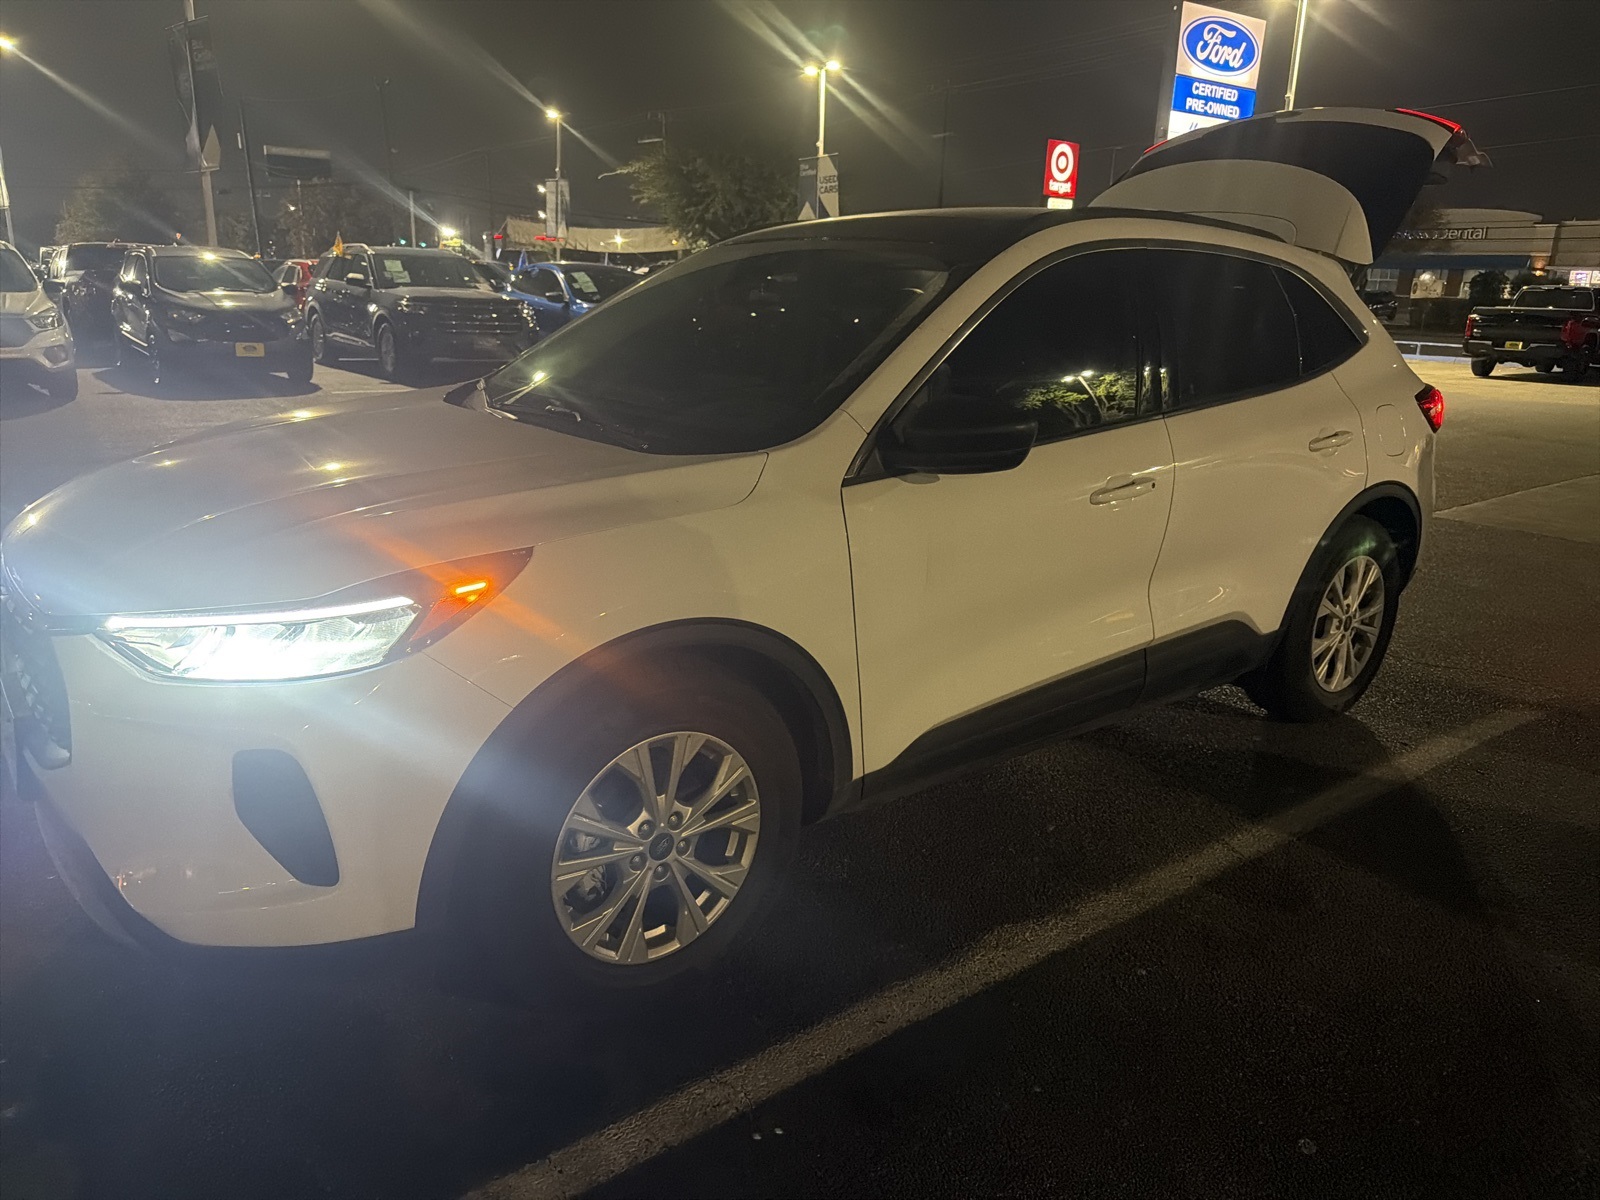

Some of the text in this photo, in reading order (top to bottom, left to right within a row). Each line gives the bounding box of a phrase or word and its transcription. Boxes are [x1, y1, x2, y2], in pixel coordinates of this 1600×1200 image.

[1196, 23, 1247, 69] Ford
[1191, 81, 1238, 102] CERTIFIED
[1185, 97, 1240, 119] PRE-OWNED
[819, 175, 837, 184] USED
[819, 185, 838, 194] CARS
